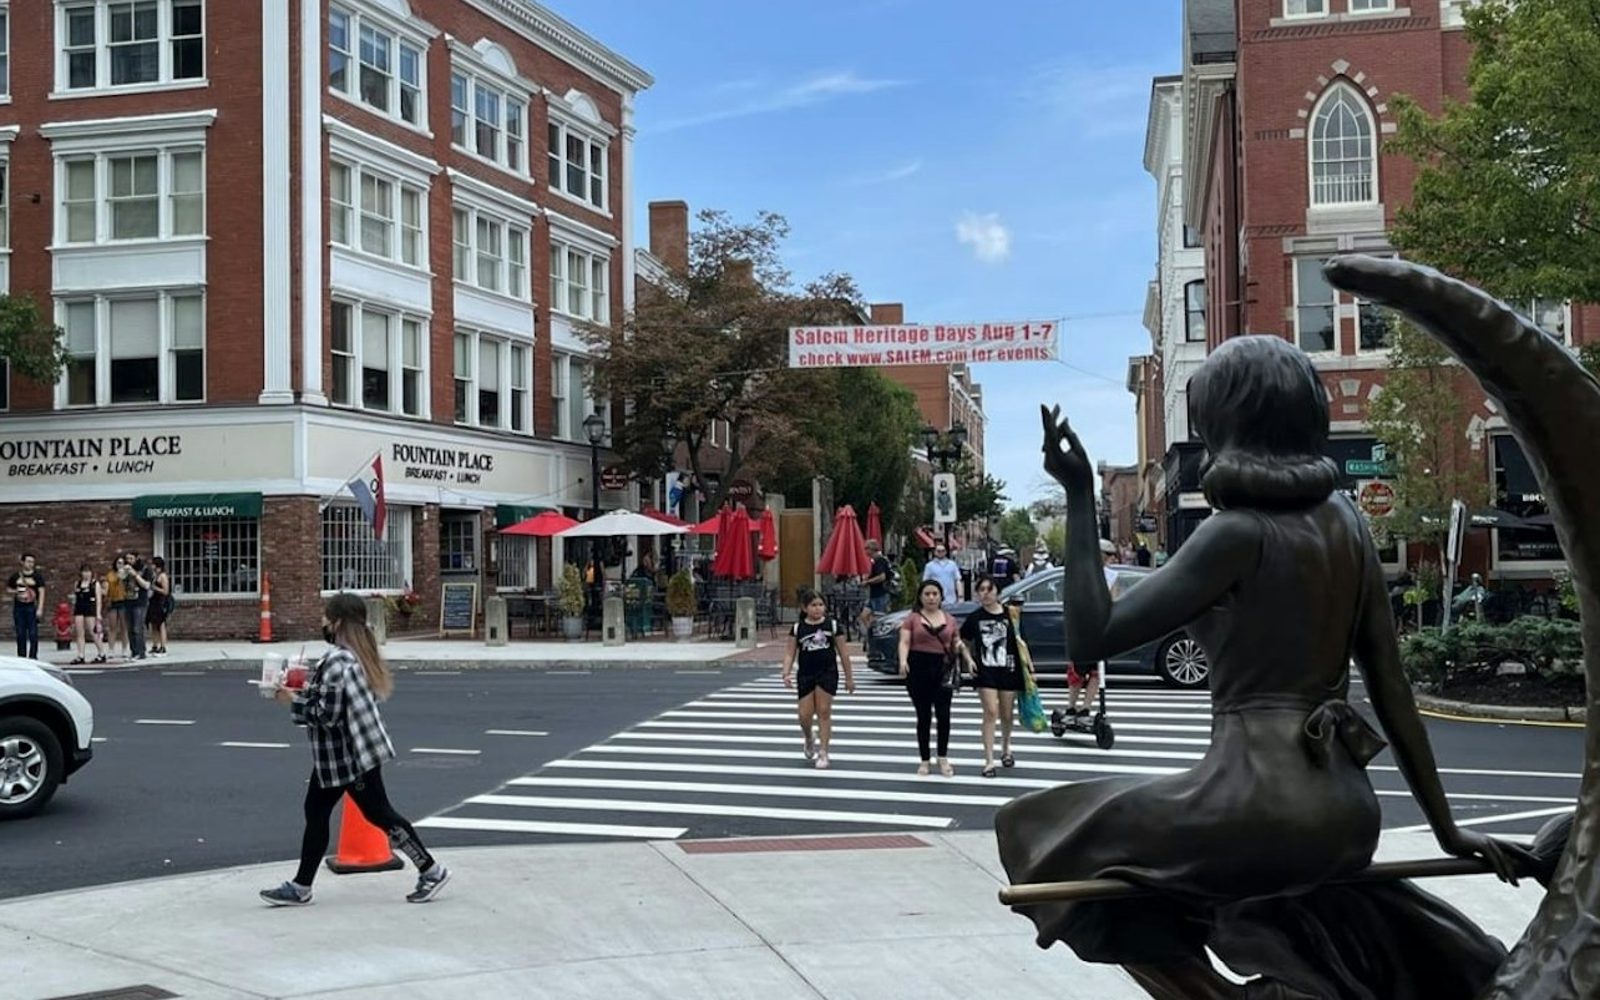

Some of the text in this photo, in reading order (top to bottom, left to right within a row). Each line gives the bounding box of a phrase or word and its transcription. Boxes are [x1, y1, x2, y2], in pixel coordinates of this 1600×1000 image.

[794, 323, 1053, 346] Salem Heritage Days Aug 1-7
[799, 346, 1050, 366] check www.SALEM.com for events
[0, 435, 182, 460] OUNTAIN PLACE
[392, 443, 494, 472] FOUNTAIN PLACE
[8, 460, 155, 477] BREAKFAST LUNCH
[405, 466, 482, 484] BREAKFAST LUNCH
[146, 506, 235, 518] BREAKFAST & LUNCH
